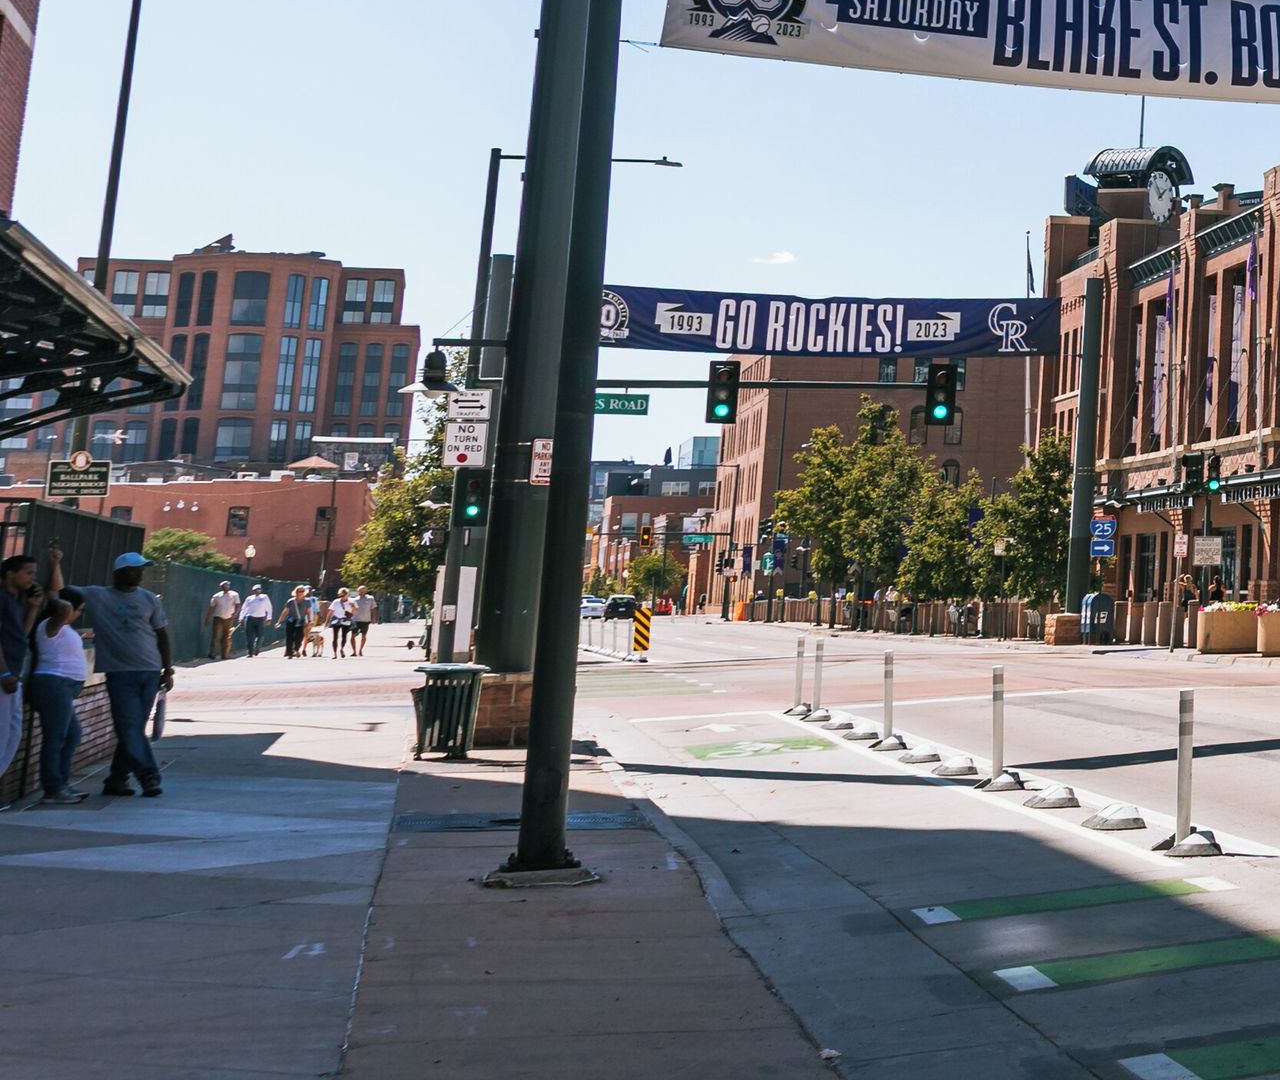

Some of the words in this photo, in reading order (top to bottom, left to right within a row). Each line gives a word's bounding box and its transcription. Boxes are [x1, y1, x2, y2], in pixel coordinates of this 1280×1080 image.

[689, 13, 715, 27] 1993
[776, 23, 802, 38] 2023
[669, 314, 703, 332] 1993
[715, 298, 757, 349] GO
[765, 300, 905, 353] ROCKIES!
[988, 302, 1030, 352] CR
[915, 322, 947, 338] 2023
[609, 398, 646, 411] ROAD
[458, 424, 475, 433] NO
[454, 435, 478, 443] TURN
[447, 444, 460, 452] ON
[464, 444, 482, 453] RED
[541, 442, 551, 450] NO
[1095, 523, 1112, 535] 25
